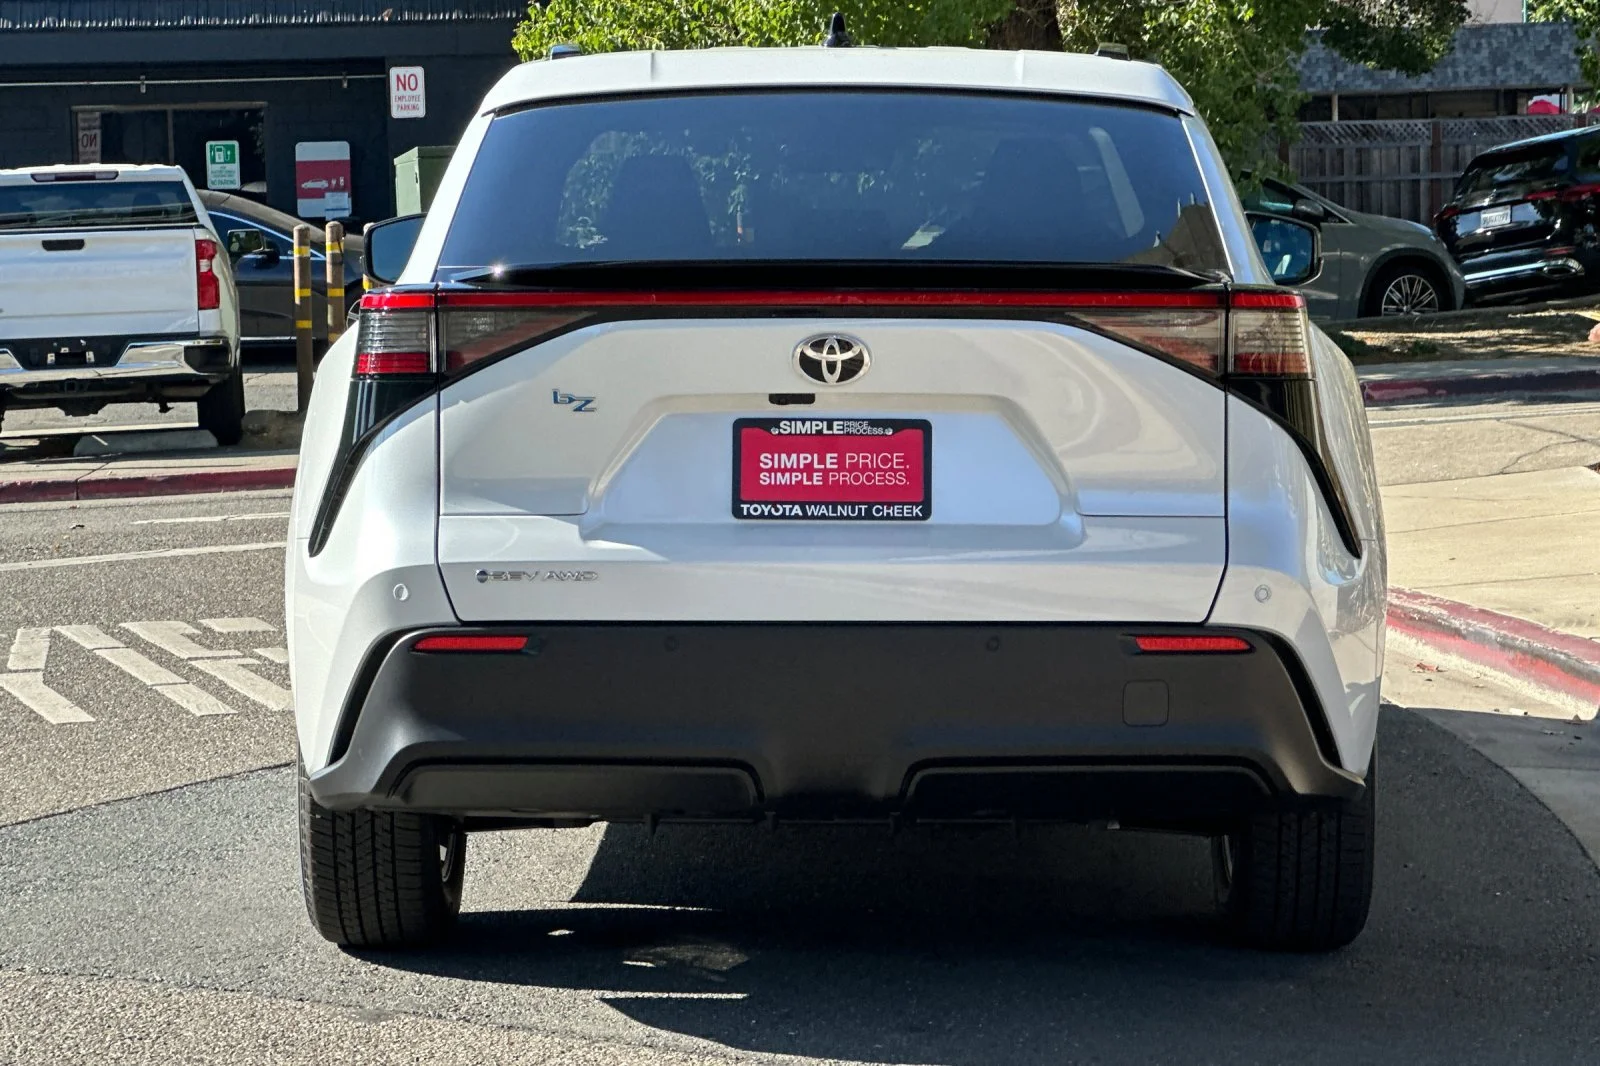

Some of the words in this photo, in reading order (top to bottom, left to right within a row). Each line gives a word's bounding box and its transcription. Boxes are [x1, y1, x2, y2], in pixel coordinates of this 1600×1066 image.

[396, 73, 418, 91] NO
[394, 95, 421, 103] EMPLOYEE
[780, 421, 843, 435] SIMPLE
[759, 453, 838, 469] SIMPLE
[845, 453, 910, 469] PRICE.
[759, 472, 823, 485] SIMPLE
[829, 472, 910, 485] PROCESS.
[740, 504, 803, 516] TOYOTA
[805, 504, 868, 517] WALNUT
[543, 570, 599, 582] AWD
